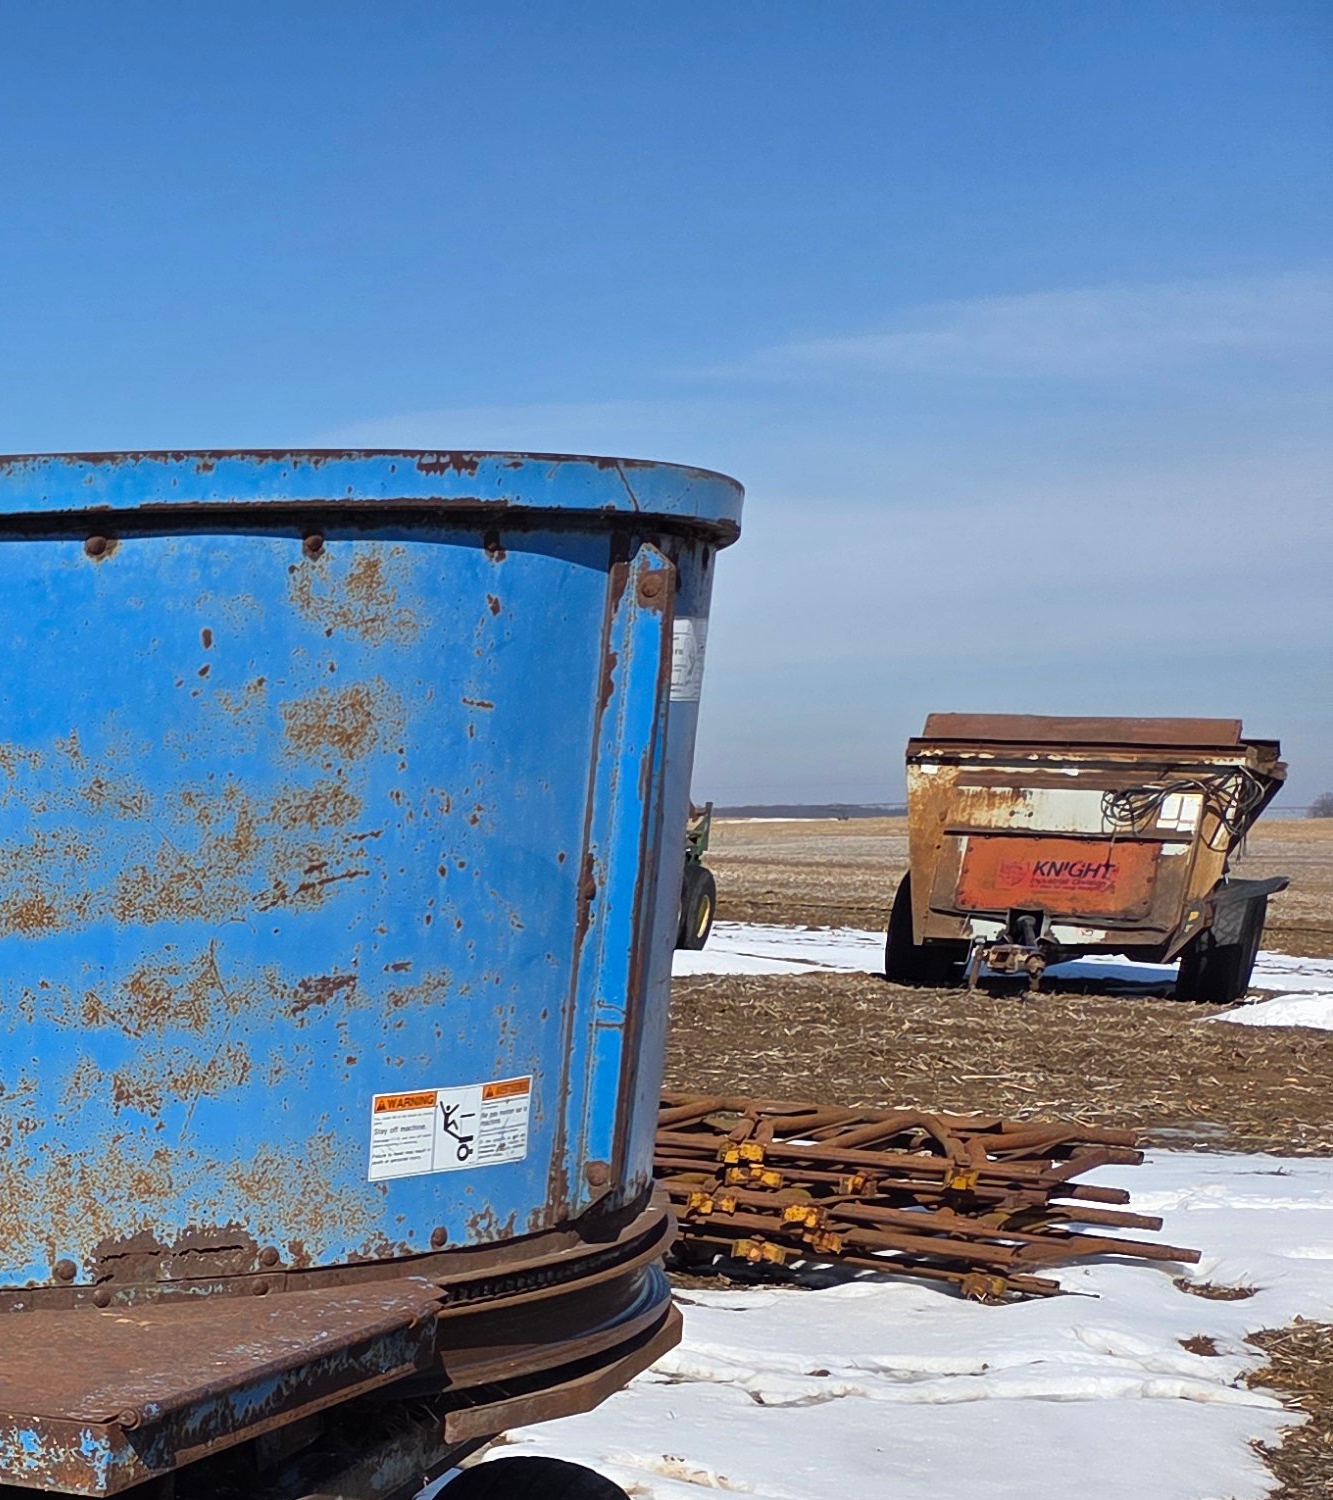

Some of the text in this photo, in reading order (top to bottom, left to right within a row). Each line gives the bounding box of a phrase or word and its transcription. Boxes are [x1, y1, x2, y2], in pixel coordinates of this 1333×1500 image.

[1033, 860, 1115, 880] KNIGHT
[388, 1094, 435, 1109] WARNING
[373, 1127, 388, 1136] Stay
[390, 1125, 398, 1133] off
